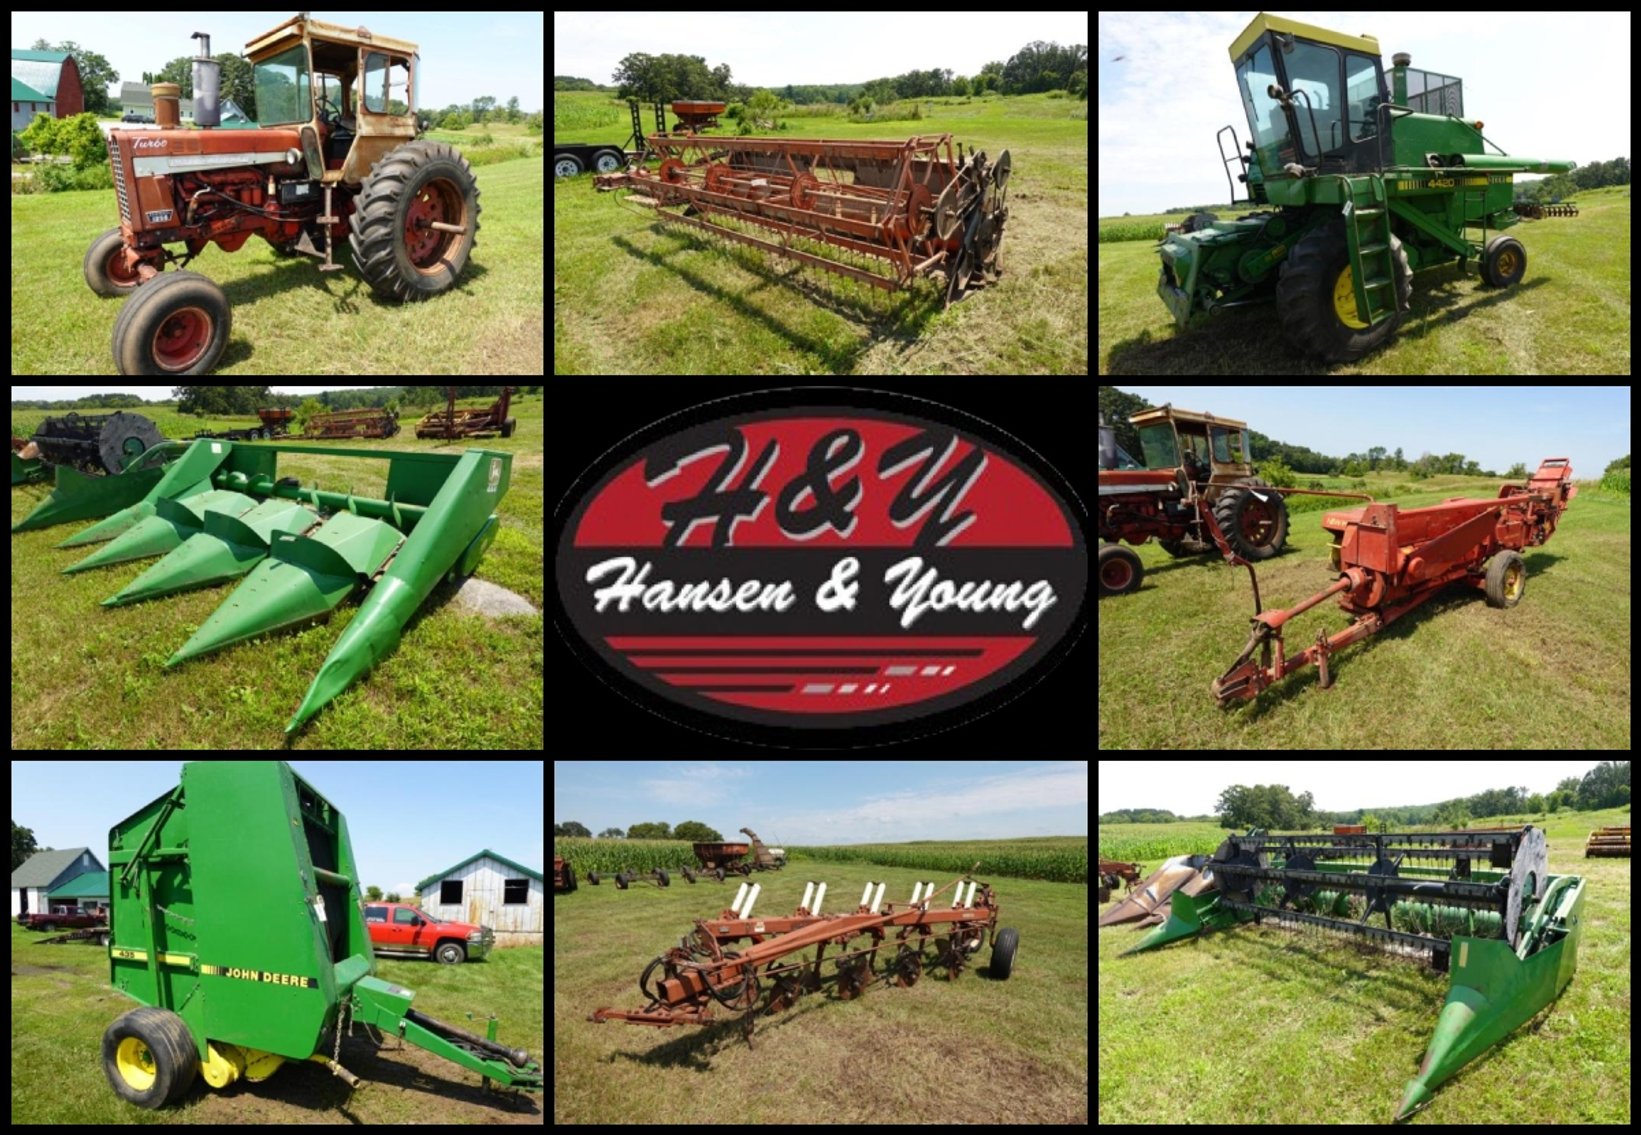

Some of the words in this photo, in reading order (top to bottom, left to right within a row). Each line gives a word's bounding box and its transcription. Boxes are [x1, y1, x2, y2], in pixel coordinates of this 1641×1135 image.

[132, 136, 168, 149] Turbo
[1428, 178, 1455, 188] 4420
[225, 967, 260, 982] JOHN
[262, 972, 310, 989] DEERE
